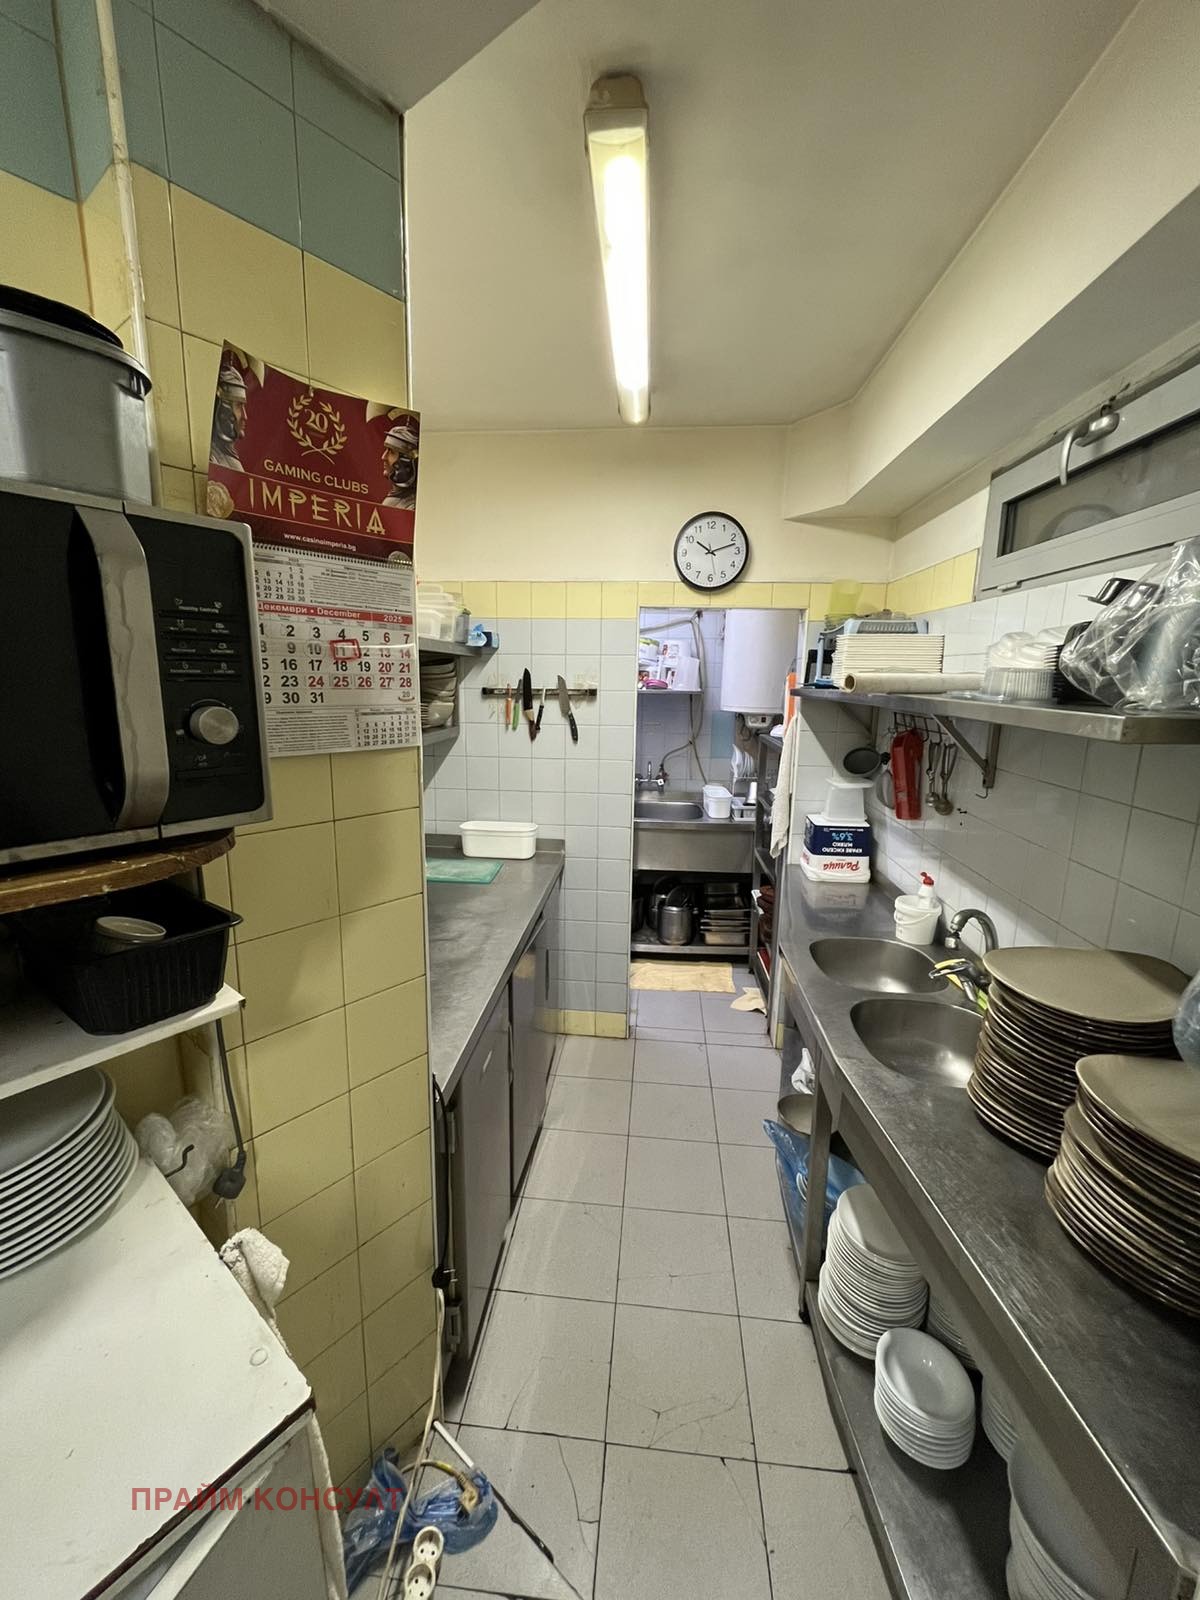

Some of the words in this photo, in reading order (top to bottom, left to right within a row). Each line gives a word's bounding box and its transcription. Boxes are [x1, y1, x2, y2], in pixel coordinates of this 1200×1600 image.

[304, 408, 328, 433] 20
[264, 458, 320, 484] GAMING
[324, 474, 369, 494] CLUBS
[249, 478, 386, 535] IMPERIA
[707, 521, 716, 529] 12
[284, 532, 356, 551] www.casinoimperia.bg
[686, 536, 694, 544] 10
[731, 533, 736, 541] 2
[682, 549, 688, 557] 9
[734, 547, 740, 555] 3
[686, 562, 691, 570] 8
[696, 570, 701, 579] 7
[707, 574, 713, 582] 6
[317, 608, 360, 618] December
[384, 614, 402, 623] 2025
[259, 623, 264, 635] 1
[286, 625, 295, 636] 2
[313, 627, 320, 638] 3
[338, 629, 345, 640] 4
[362, 631, 369, 641] 5
[384, 632, 390, 642] 6
[404, 634, 410, 644] 7
[287, 642, 296, 654] 9
[307, 643, 321, 655] 10
[280, 658, 298, 670] 16
[308, 659, 322, 671] 17
[333, 661, 348, 671] 18
[358, 661, 370, 672] 19
[399, 663, 410, 673] 21
[281, 676, 298, 687] 23
[308, 676, 324, 687] 24
[334, 676, 349, 687] 25
[358, 676, 372, 687] 26
[399, 677, 412, 687] 28
[282, 692, 300, 704] 30
[310, 692, 324, 703] 31
[832, 832, 853, 841] 3,6%
[823, 860, 860, 871] Ралица
